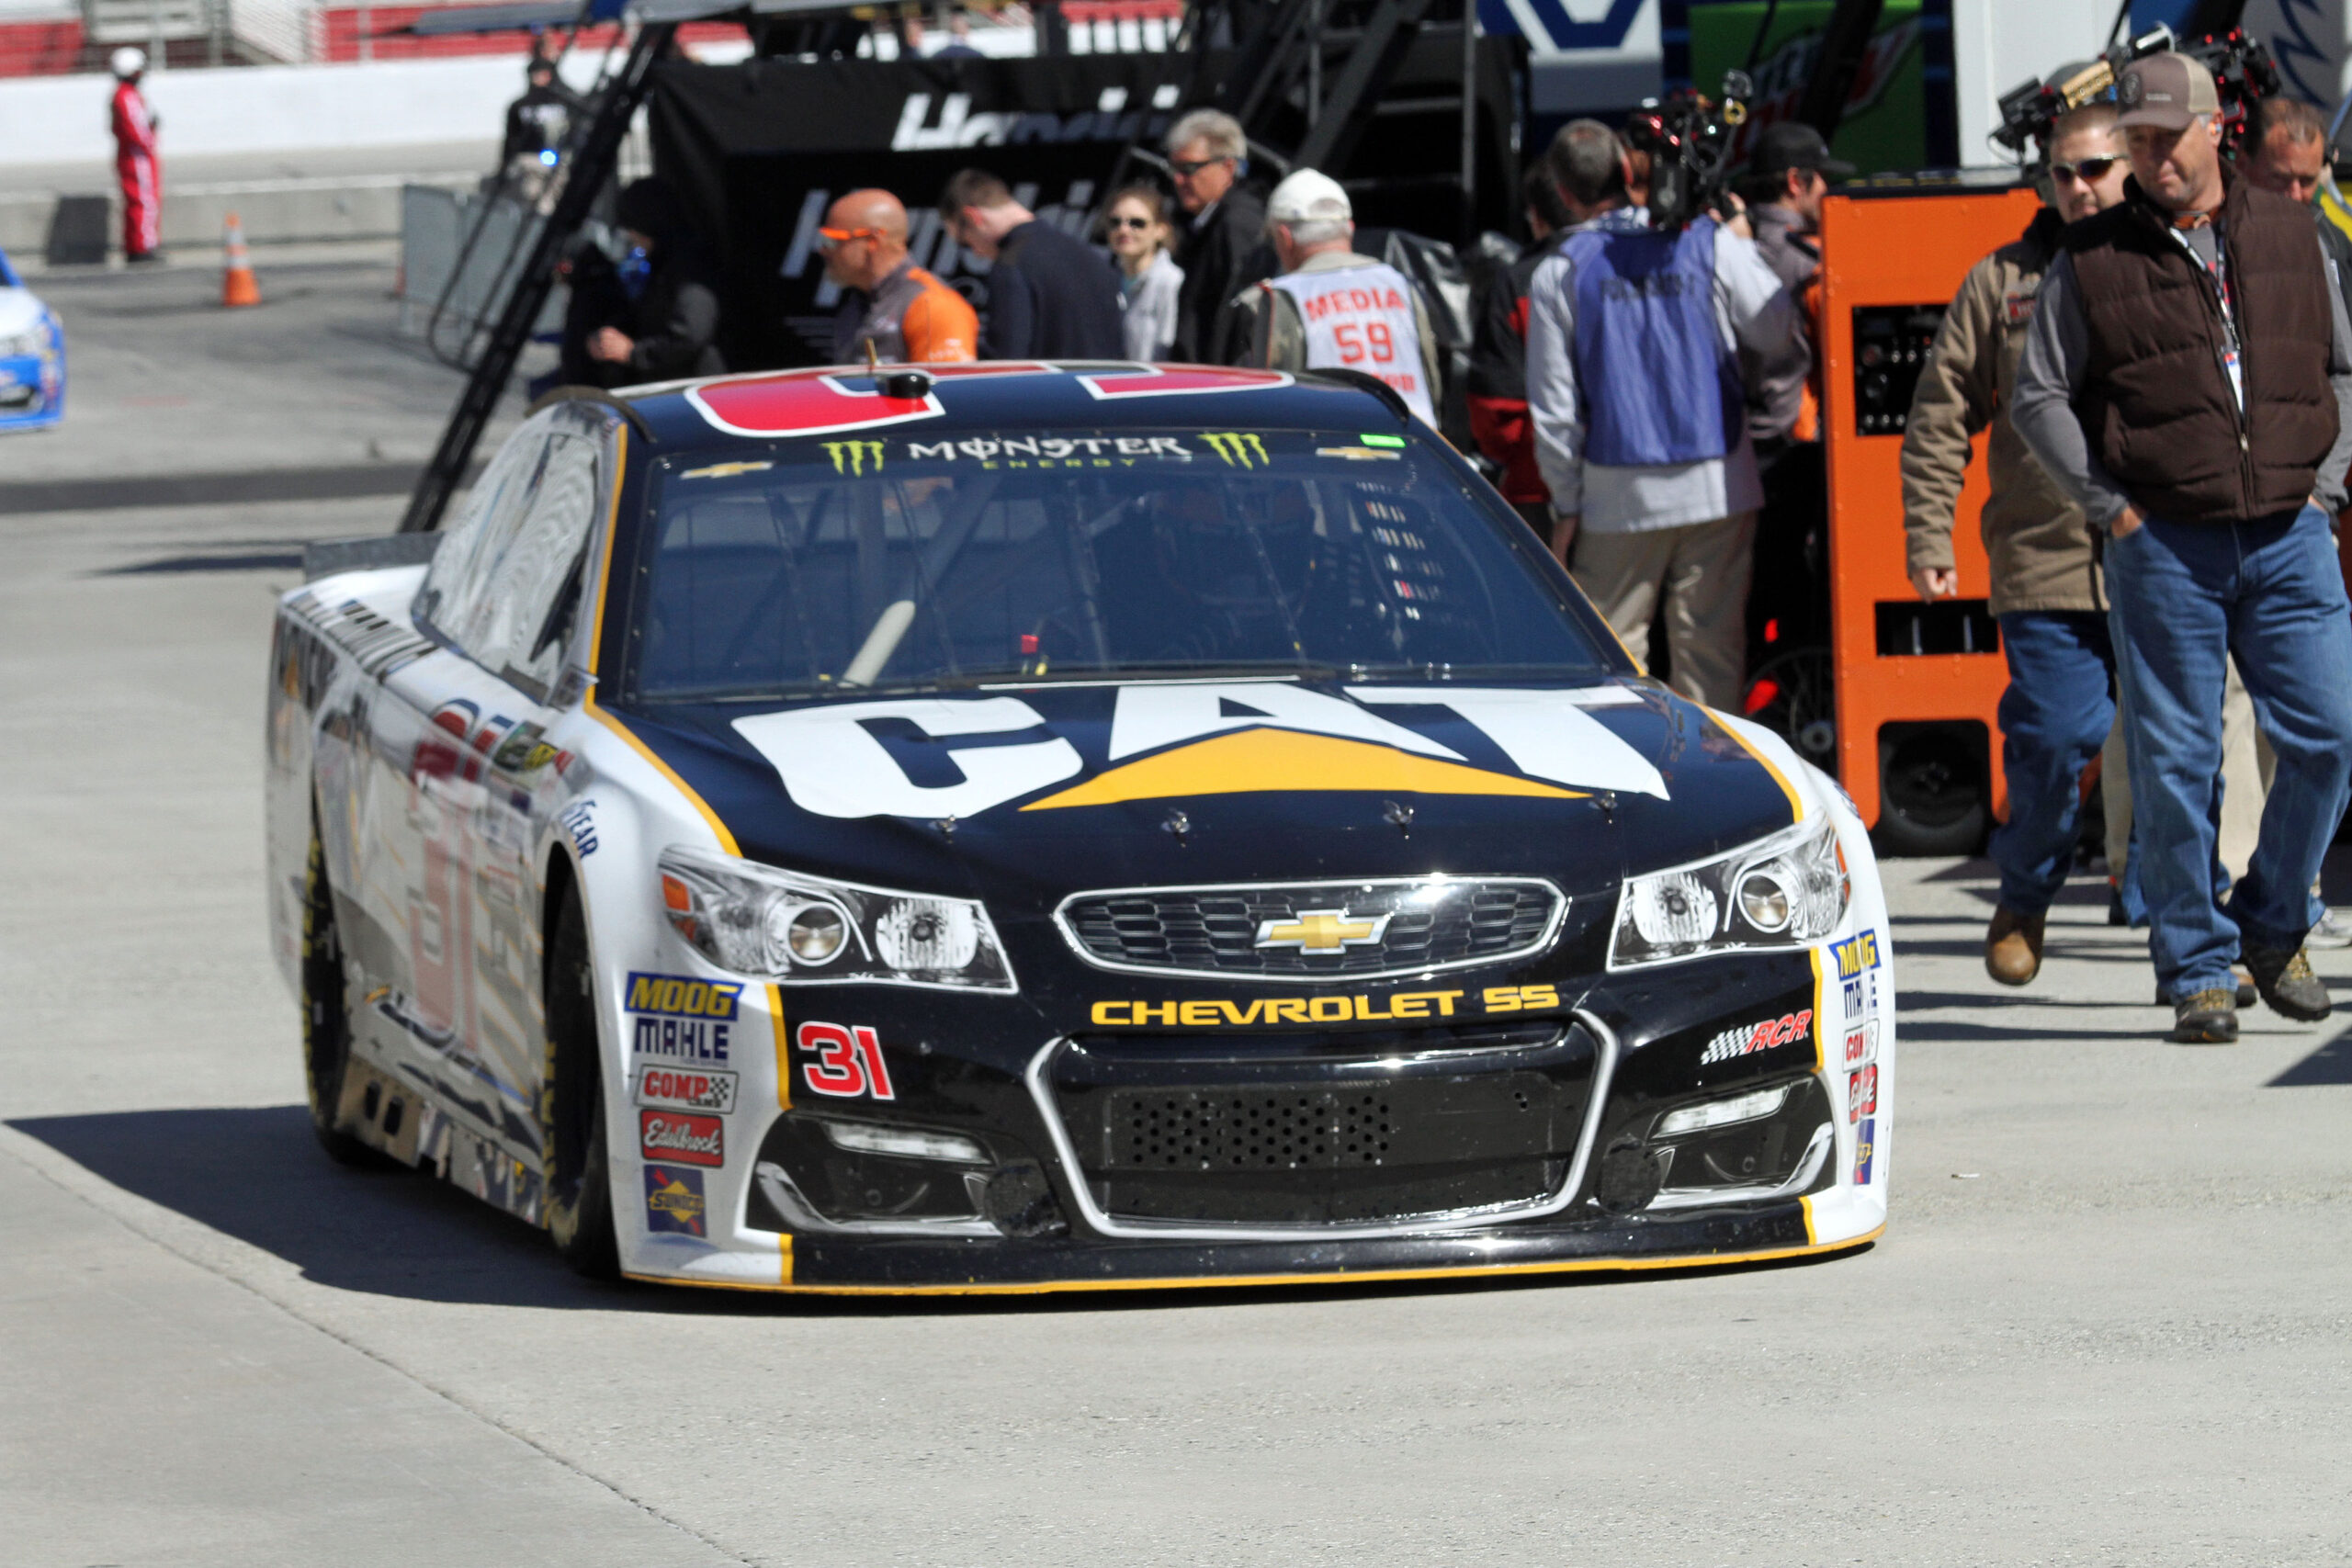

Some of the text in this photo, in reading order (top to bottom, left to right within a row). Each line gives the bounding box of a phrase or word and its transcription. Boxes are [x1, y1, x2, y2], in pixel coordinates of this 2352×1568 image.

[1305, 287, 1406, 321] MEDIA
[1333, 321, 1394, 365] 59
[909, 436, 1193, 461] MONSTER
[982, 459, 1135, 469] ENERGY
[731, 682, 1669, 819] CAT
[628, 976, 741, 1017] MOOG
[1091, 985, 1560, 1026] CHEVROLET SS
[634, 1017, 729, 1061] MAHLE
[1746, 1009, 1813, 1054] RCR
[797, 1021, 896, 1101] 31
[644, 1071, 708, 1101] COMP
[644, 1118, 722, 1156] Edelbrock
